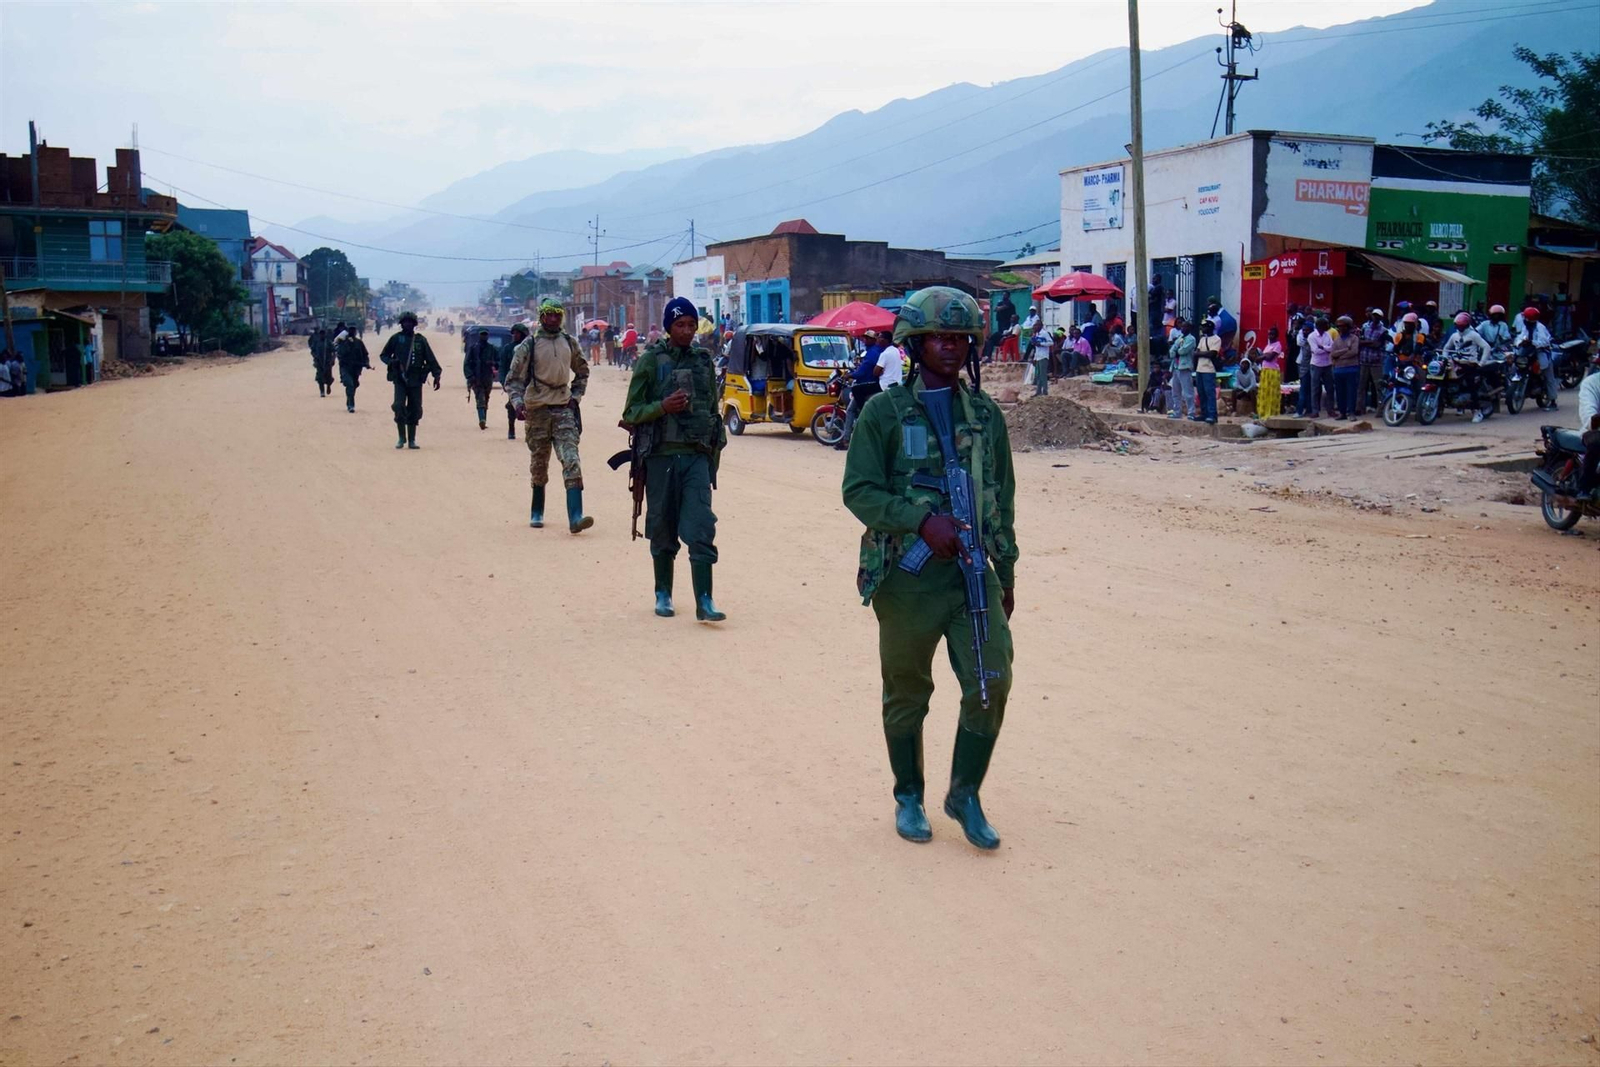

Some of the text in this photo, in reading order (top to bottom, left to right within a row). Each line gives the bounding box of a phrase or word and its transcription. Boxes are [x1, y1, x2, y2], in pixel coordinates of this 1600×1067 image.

[1102, 172, 1120, 184] PHARMA
[1298, 182, 1370, 202] PHARMACI
[1376, 222, 1423, 237] PHARMACIE
[1280, 258, 1297, 267] airtel
